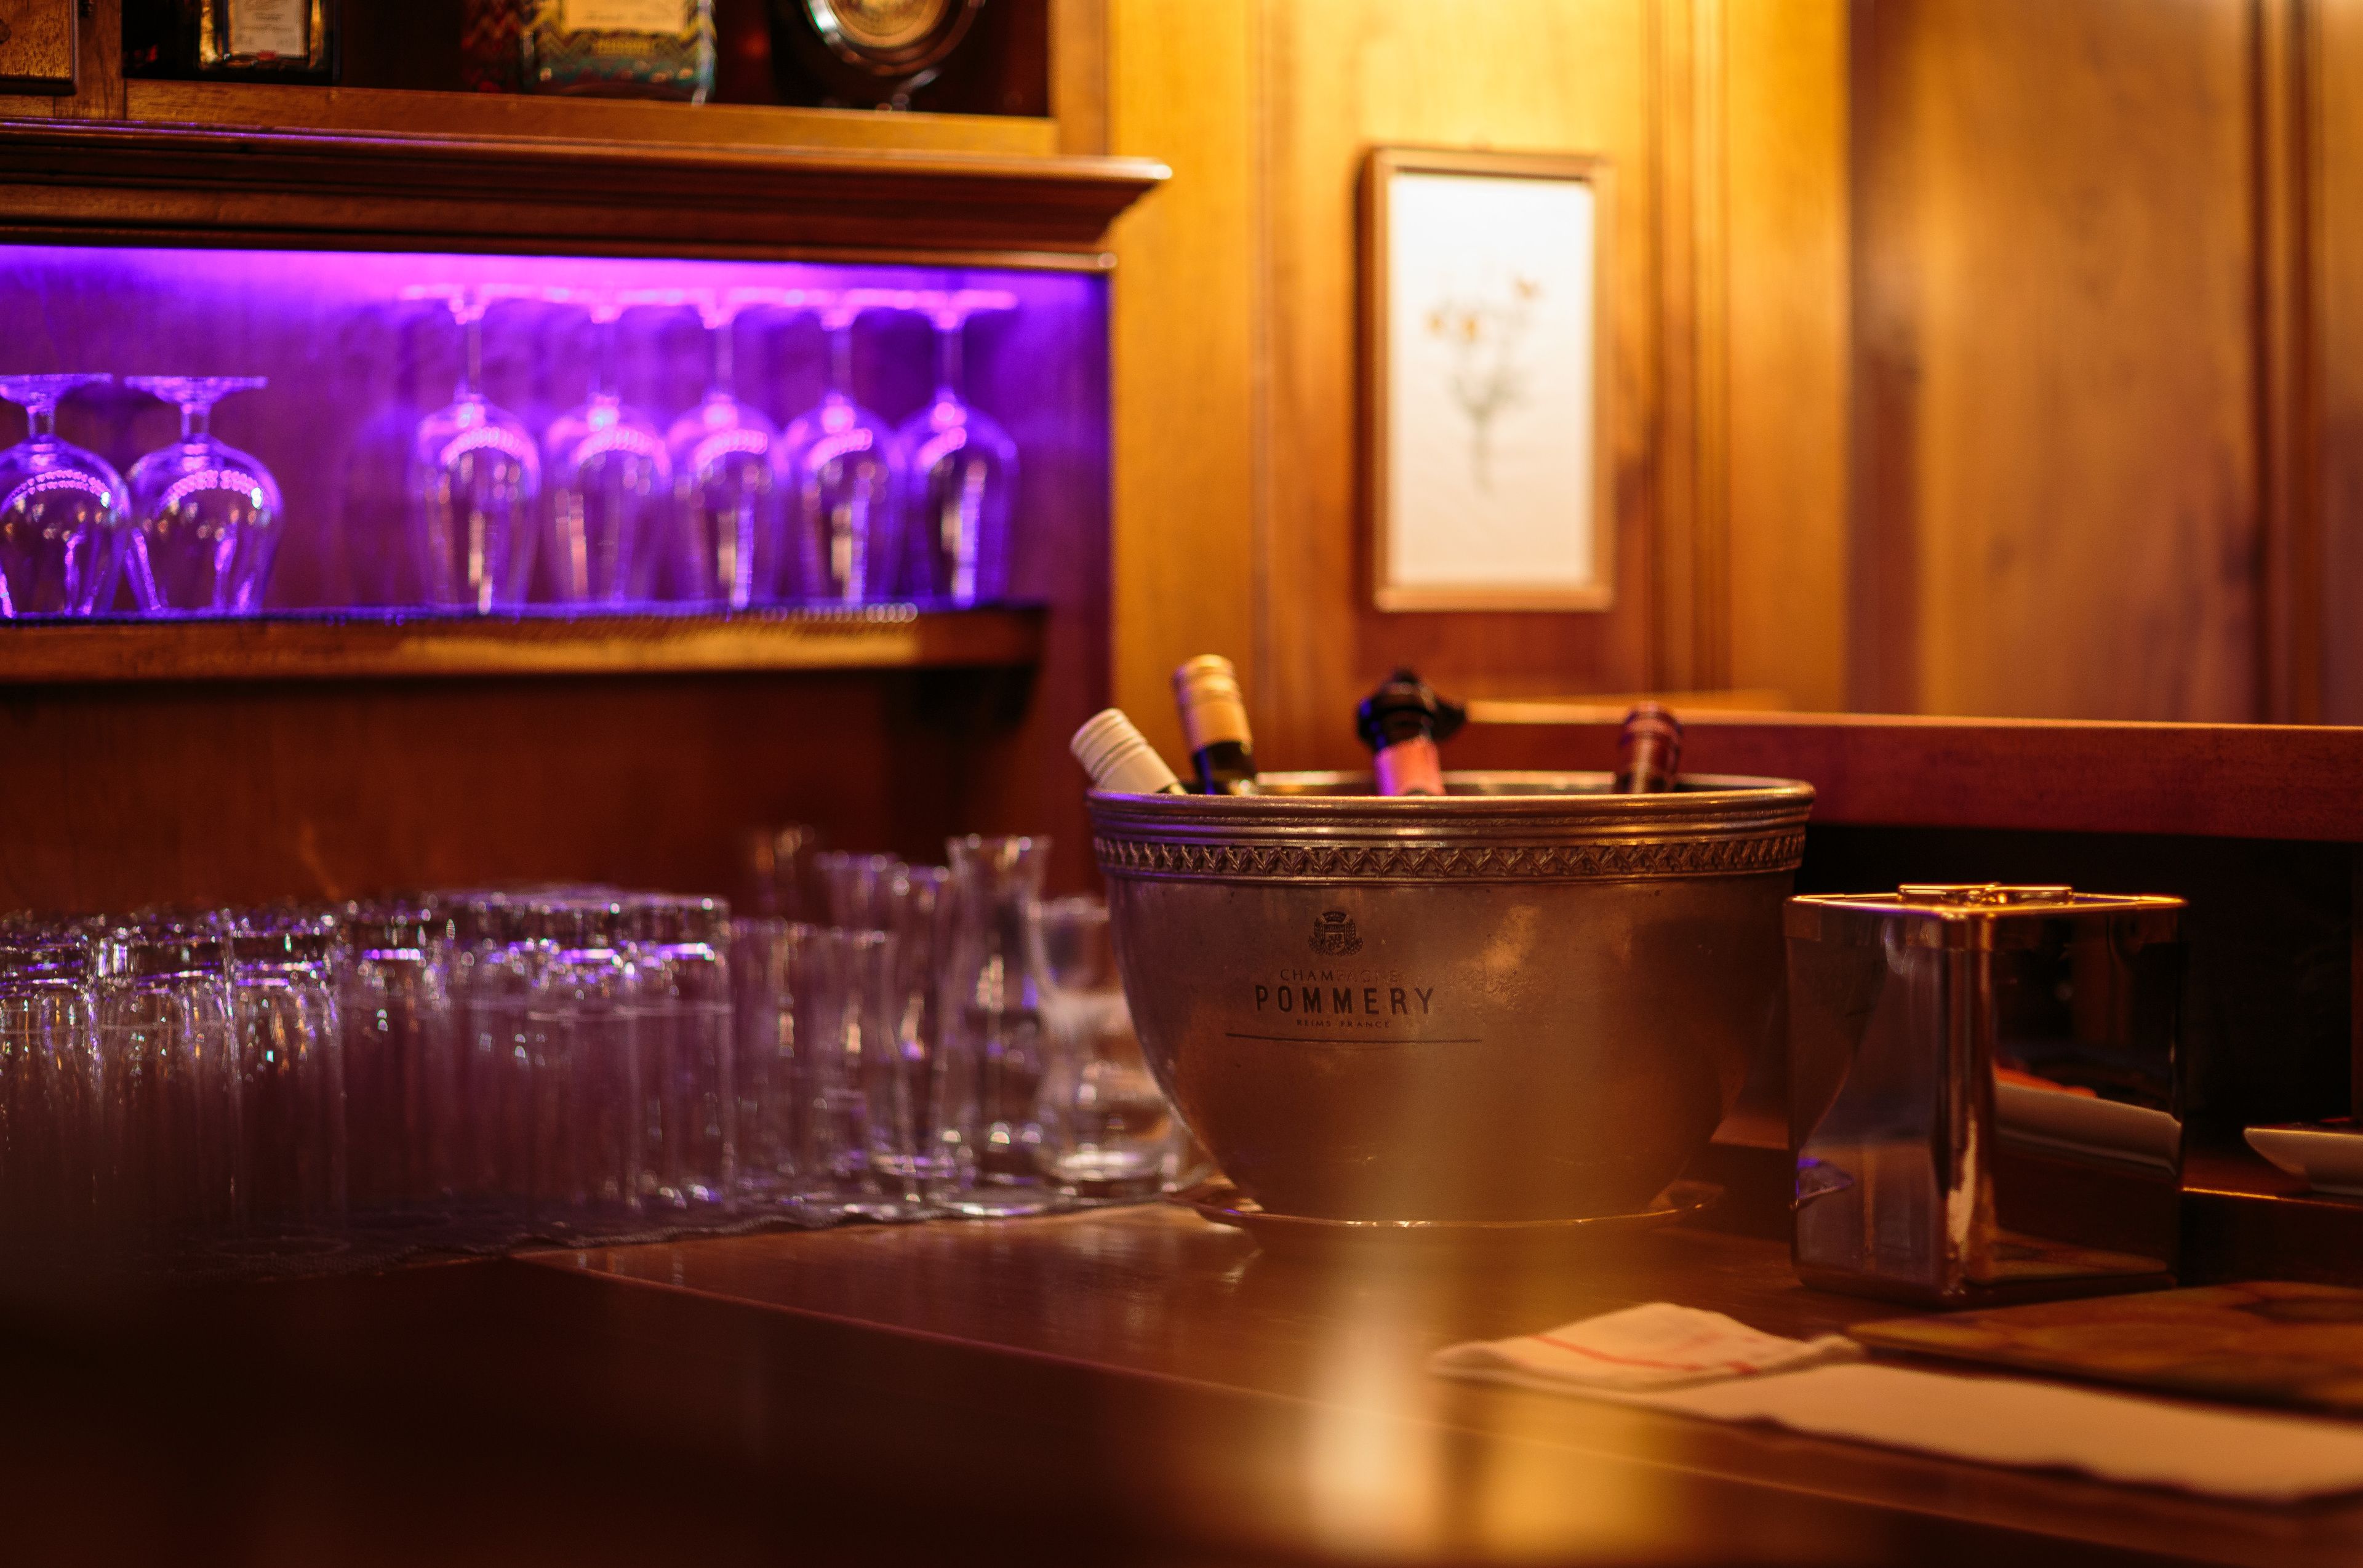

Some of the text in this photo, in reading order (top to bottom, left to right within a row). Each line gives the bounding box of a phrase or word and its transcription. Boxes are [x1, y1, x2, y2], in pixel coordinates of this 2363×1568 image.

[1255, 985, 1434, 1015] POMMERY
[1296, 1018, 1389, 1028] REIMS FRANCE
